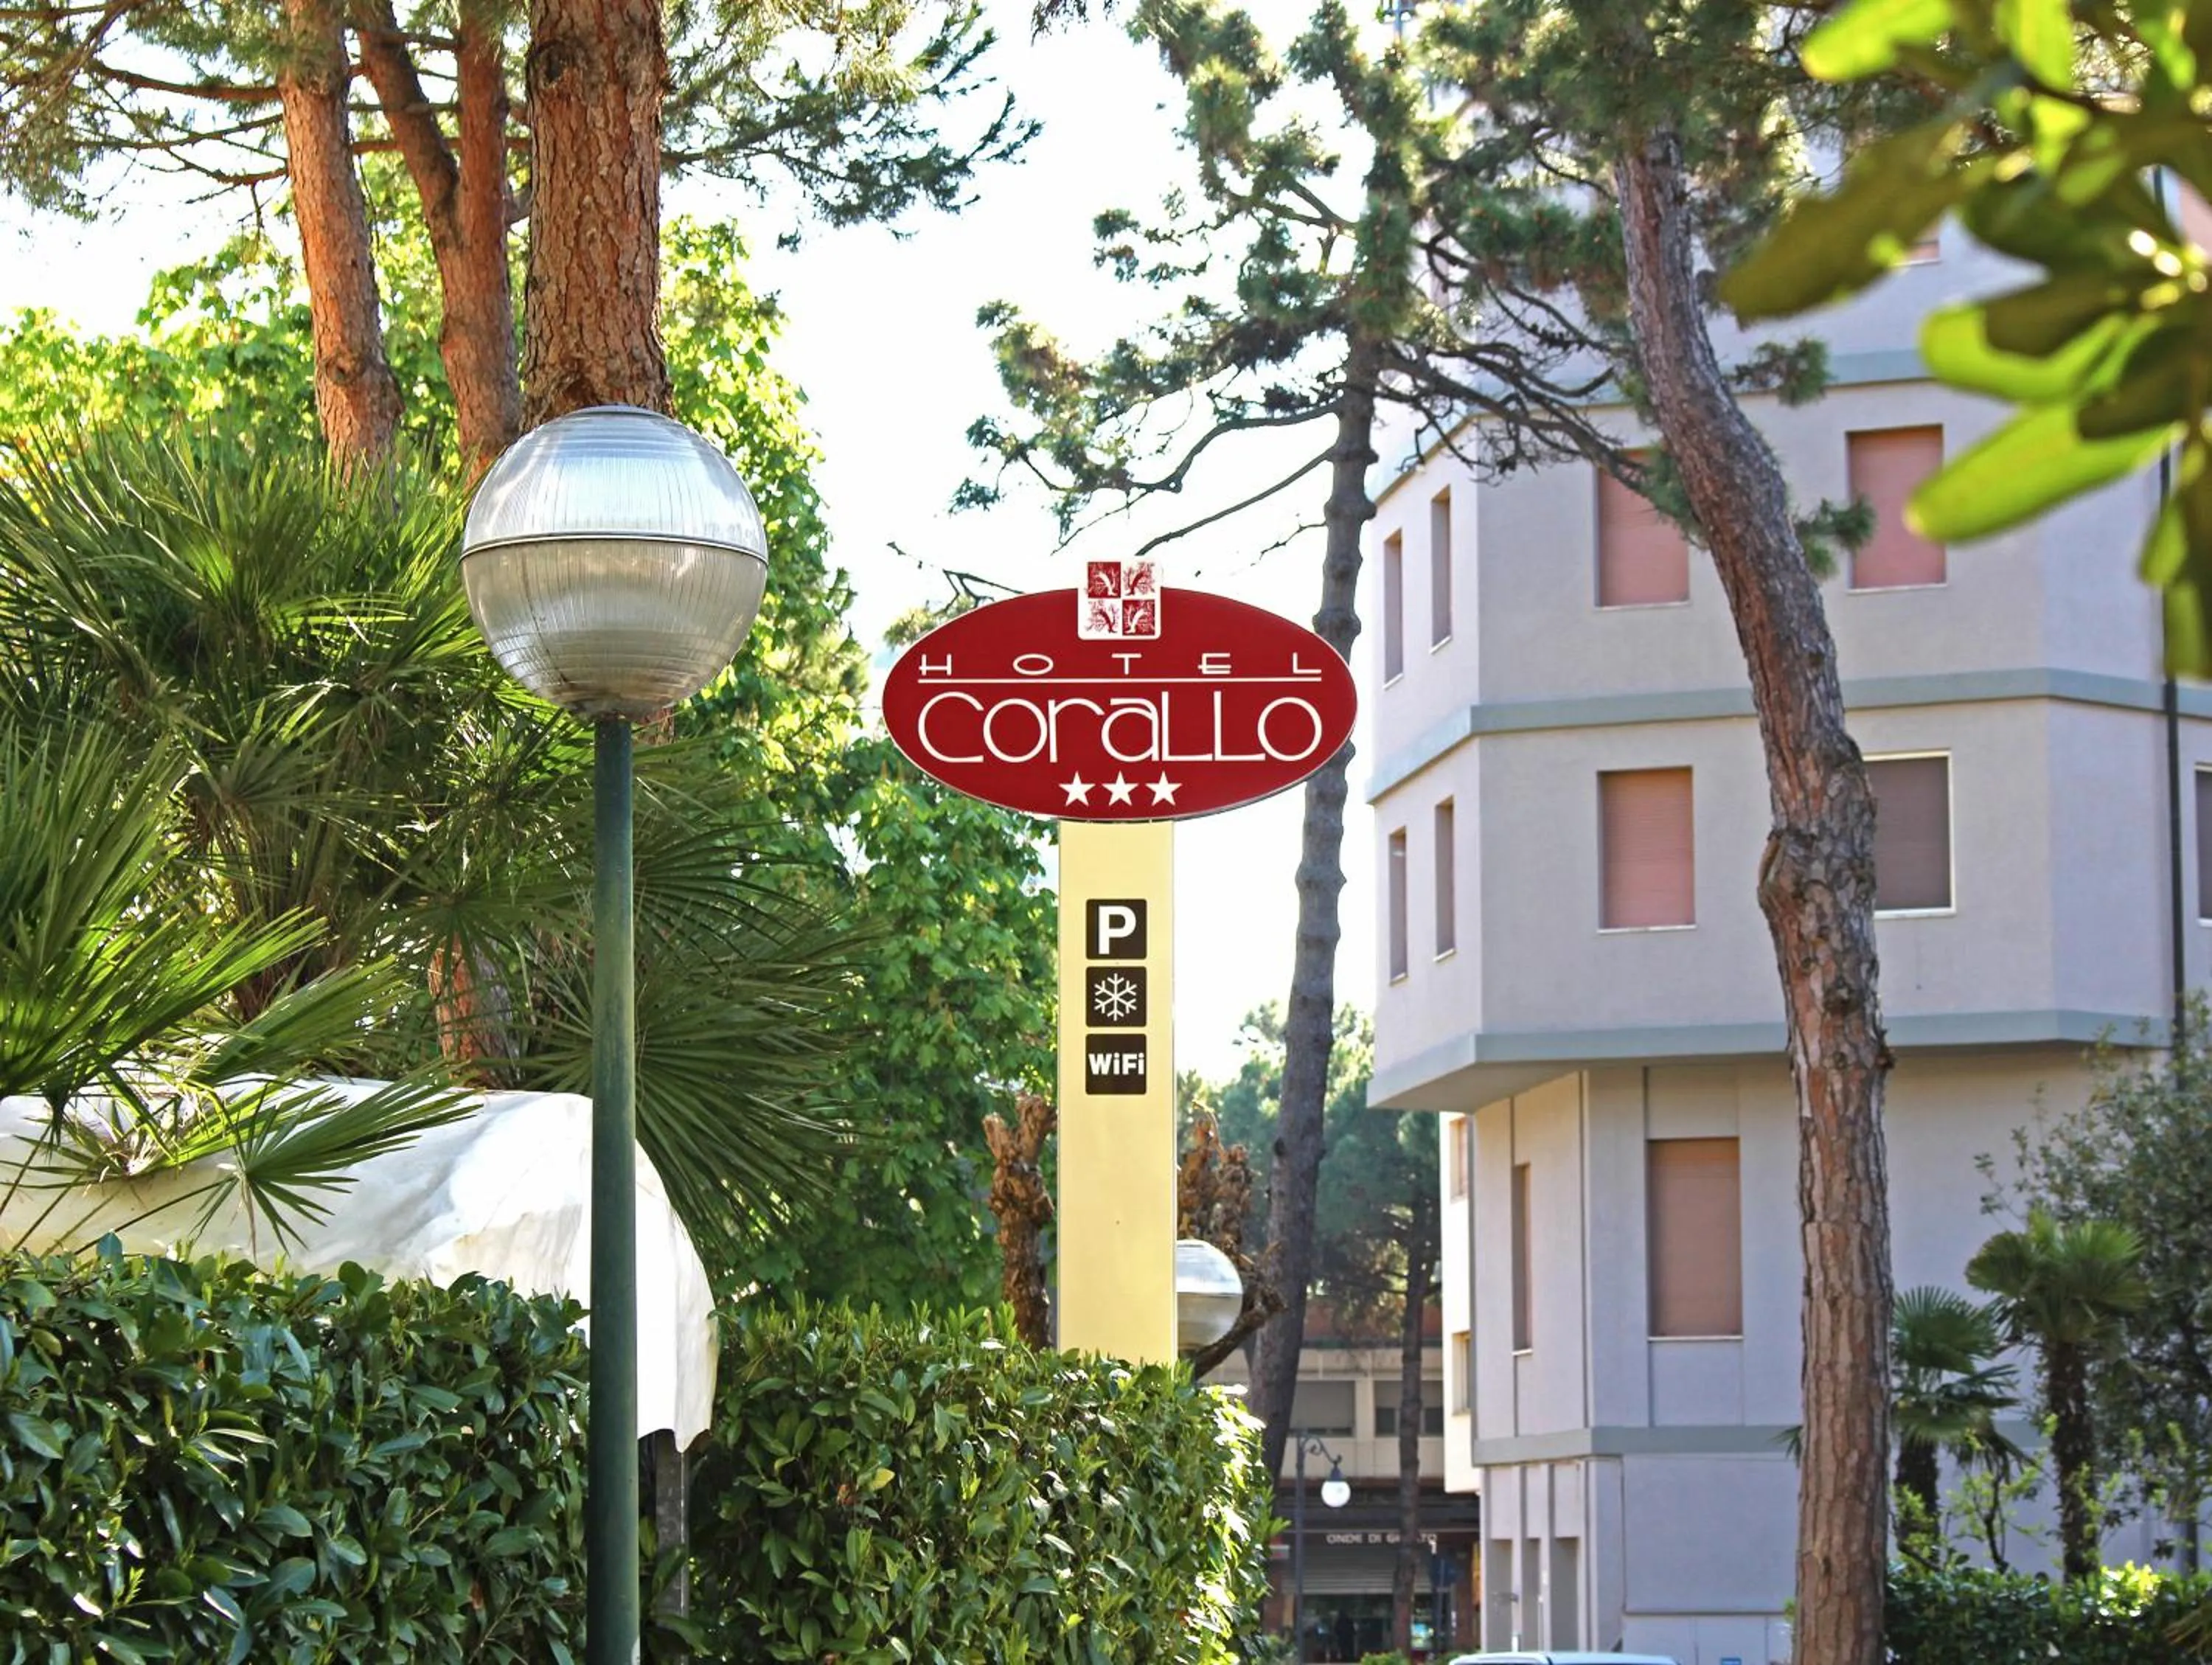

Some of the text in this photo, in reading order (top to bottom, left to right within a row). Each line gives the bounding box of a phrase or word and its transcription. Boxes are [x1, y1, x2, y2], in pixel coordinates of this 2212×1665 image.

[919, 652, 1322, 676] HOTEL
[1097, 905, 1137, 955] P
[1088, 1052, 1145, 1076] WiFi
[1368, 1533, 1382, 1544] DI
